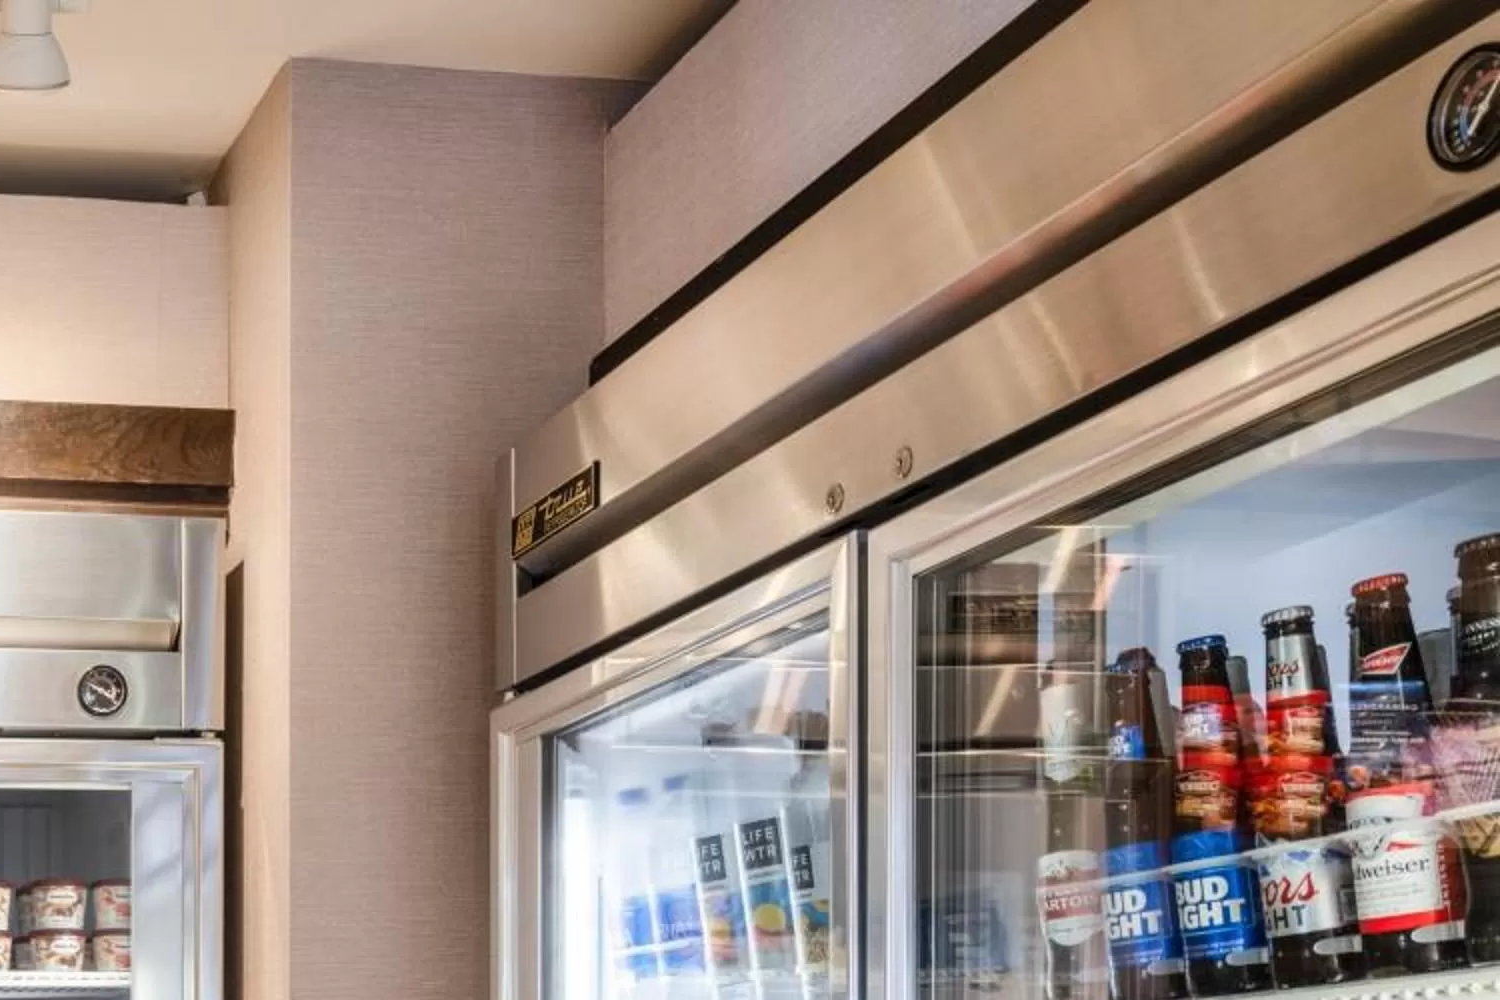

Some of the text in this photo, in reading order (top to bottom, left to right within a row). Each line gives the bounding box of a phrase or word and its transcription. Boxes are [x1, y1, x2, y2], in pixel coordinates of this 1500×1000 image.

[1106, 888, 1148, 915] UD
[1264, 871, 1320, 907] ors
[1106, 910, 1164, 940] GHT
[1179, 897, 1246, 931] IGHT
